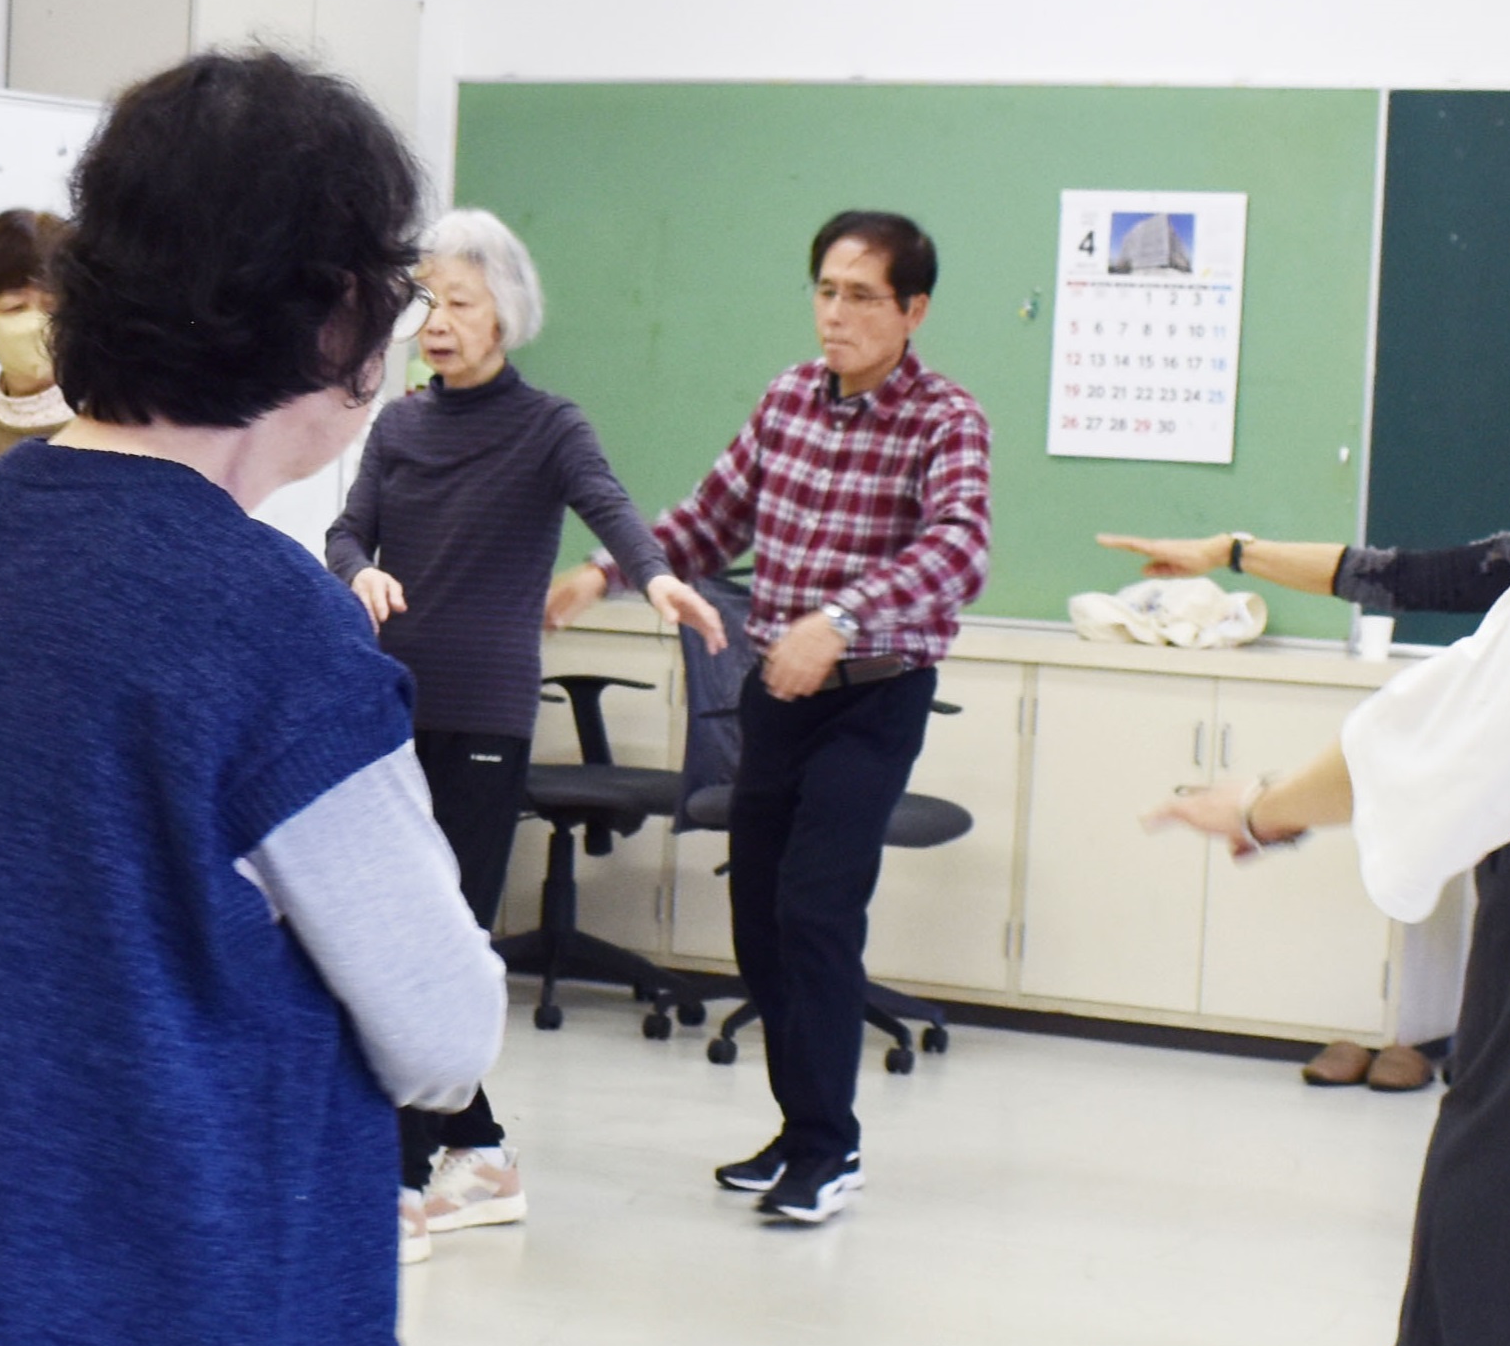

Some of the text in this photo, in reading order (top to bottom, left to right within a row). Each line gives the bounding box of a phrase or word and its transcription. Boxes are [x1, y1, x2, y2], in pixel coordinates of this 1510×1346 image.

[1079, 231, 1095, 256] 4
[1188, 324, 1205, 339] 10
[1066, 352, 1082, 366] 12
[1089, 353, 1106, 368] 13
[1114, 354, 1130, 368] 14
[1138, 355, 1154, 369] 15
[1186, 356, 1203, 370] 17
[1064, 383, 1081, 398] 19
[1087, 384, 1106, 399] 20
[1112, 385, 1127, 400] 21
[1135, 386, 1153, 401] 22
[1159, 387, 1177, 402] 23
[1184, 389, 1201, 402] 24
[1085, 416, 1103, 431] 27
[1110, 418, 1127, 431] 28
[1134, 419, 1152, 433] 29
[1158, 419, 1176, 434] 30
